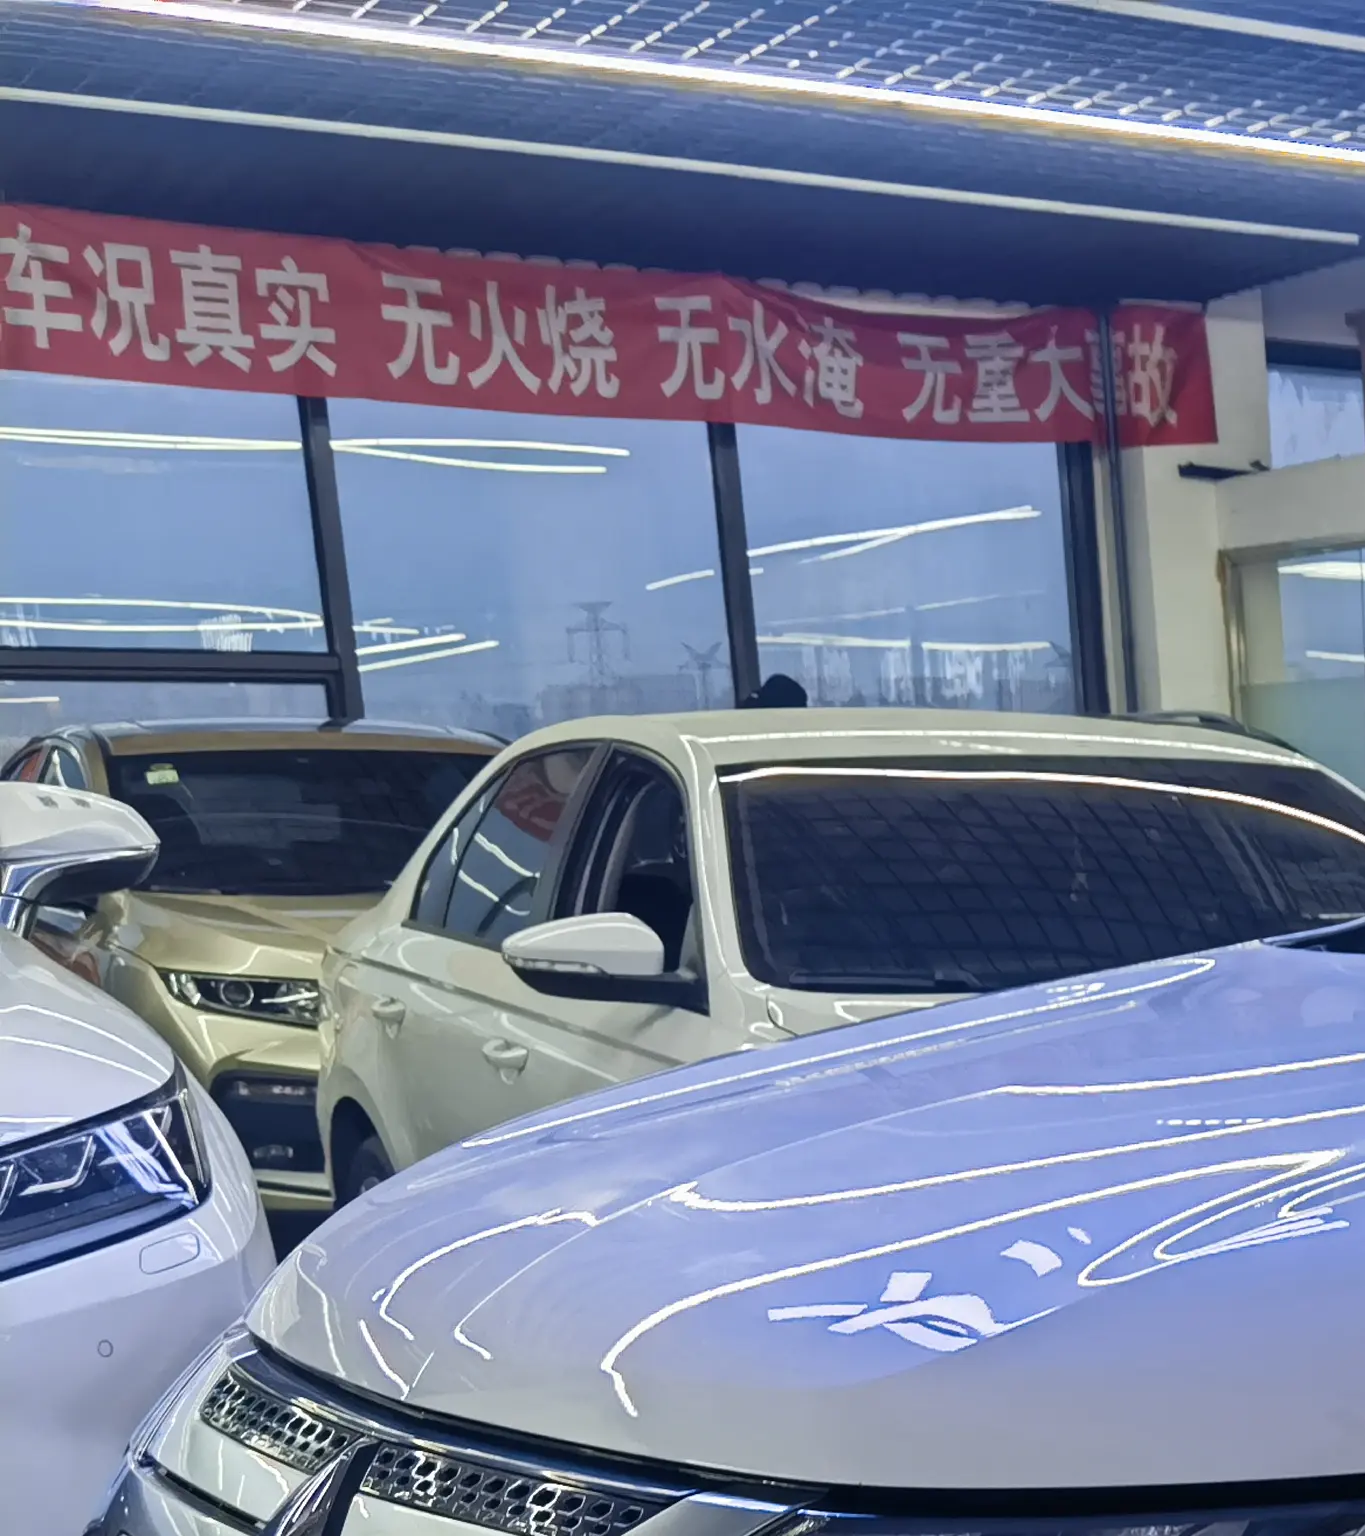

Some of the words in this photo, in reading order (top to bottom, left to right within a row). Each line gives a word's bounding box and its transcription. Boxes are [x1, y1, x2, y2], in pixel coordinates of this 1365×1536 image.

[0, 222, 337, 378] 车况真实
[381, 270, 621, 400] 无火烧
[654, 295, 864, 420] 无水淹
